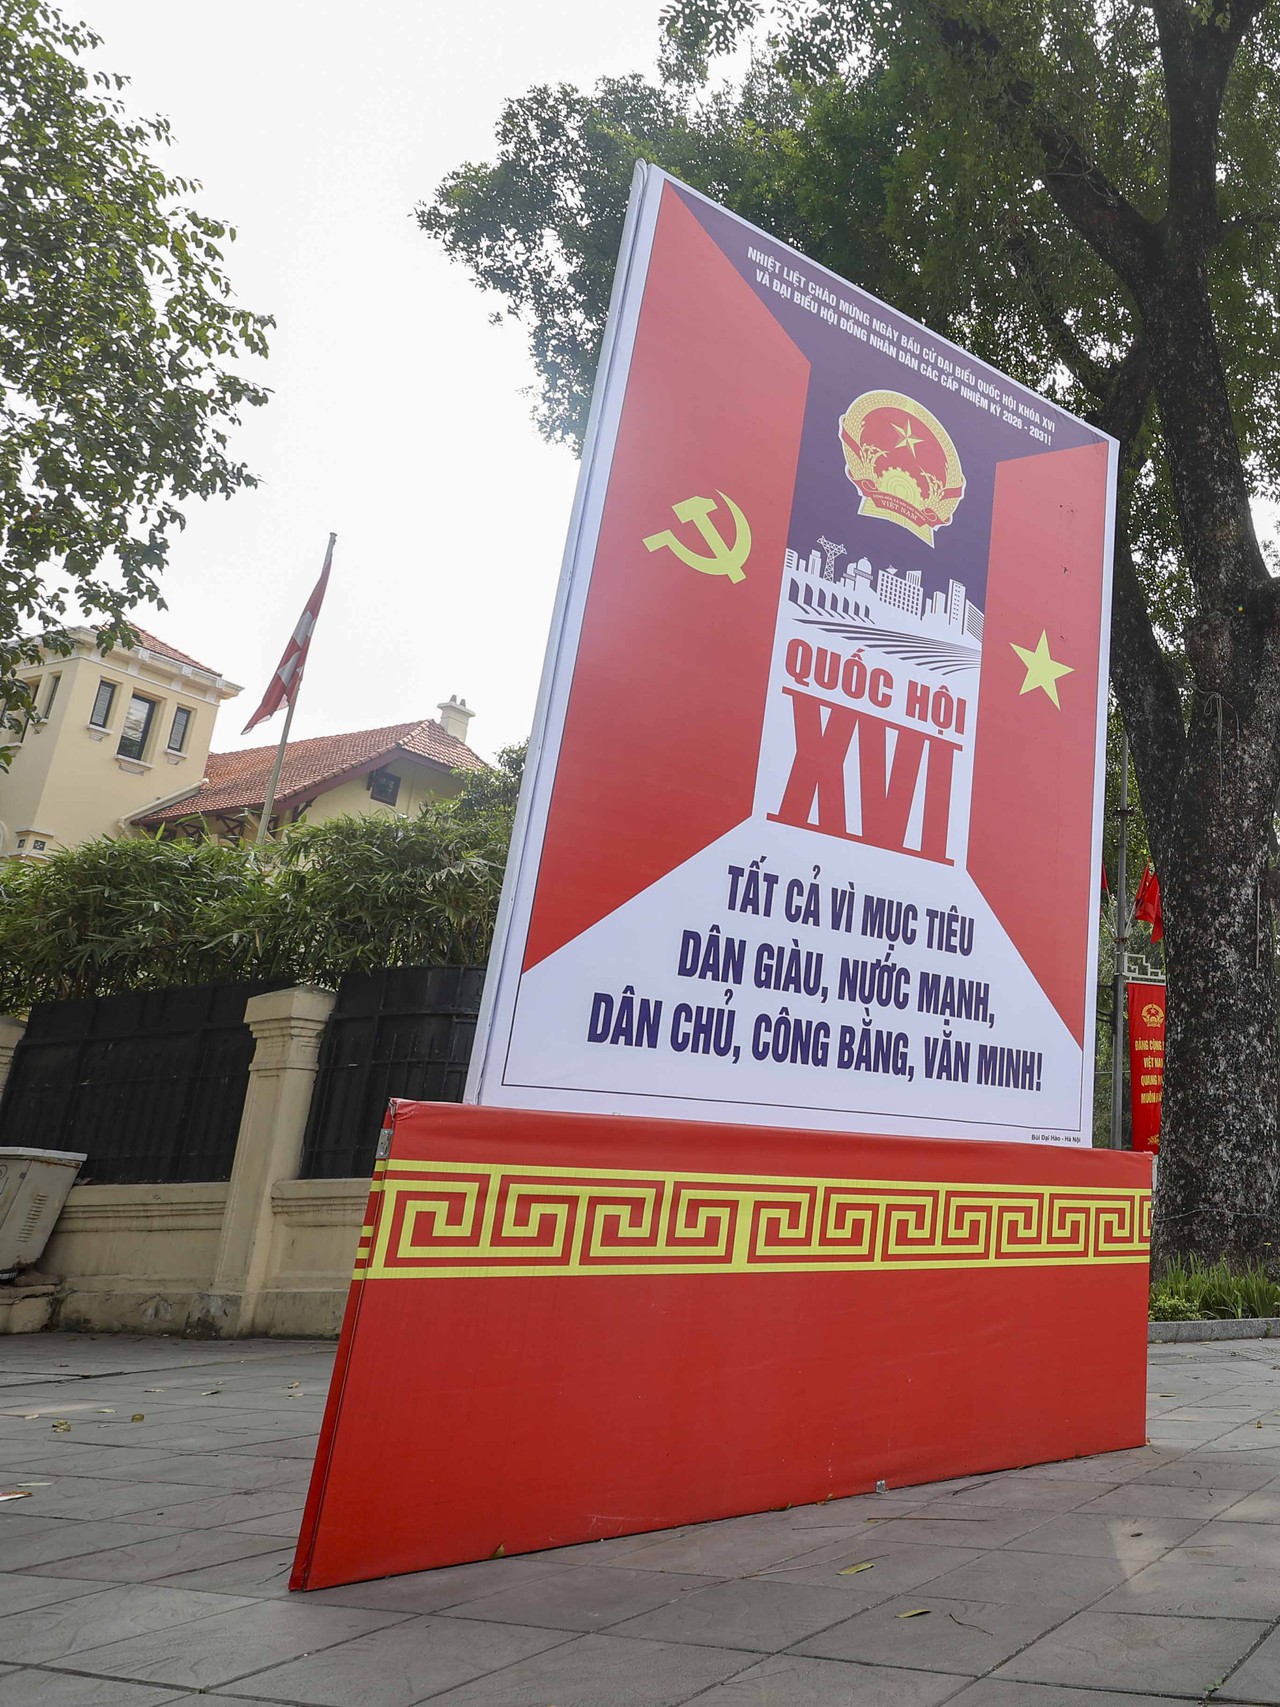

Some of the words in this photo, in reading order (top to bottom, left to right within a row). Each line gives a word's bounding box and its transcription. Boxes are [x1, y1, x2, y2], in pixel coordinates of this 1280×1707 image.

[747, 246, 781, 274] NHIỆT
[783, 266, 806, 288] LIỆT
[808, 281, 837, 306] CHÀO
[839, 299, 870, 327] MỪNG
[872, 318, 899, 342] NGÀY
[922, 347, 937, 363] CỬ
[937, 355, 953, 374] ĐẠI
[955, 366, 976, 386] BIỂU
[977, 378, 1001, 401] QUỐC
[1002, 393, 1017, 411] HỘI
[1018, 403, 1040, 424] KHÓA
[1042, 416, 1056, 433] XVI
[755, 269, 770, 287] VÀ
[772, 278, 792, 299] ĐẠI
[793, 290, 819, 314] BIỂU
[820, 305, 839, 325] HỘI
[839, 317, 868, 342] ĐỒNG
[869, 333, 897, 359] NHÂN
[898, 350, 919, 371] DÂN
[920, 362, 939, 382] CÁC
[940, 374, 959, 392] CẤP
[960, 385, 989, 410] NHIỆM
[990, 402, 1001, 417] KỲ
[1002, 410, 1023, 430] 2026
[1029, 425, 1052, 446] 2031!
[785, 638, 894, 709] QUỐC
[905, 678, 967, 736] HỘI
[766, 685, 963, 867] XVI
[727, 855, 779, 918] TẤT
[785, 864, 821, 927] CẢ
[831, 881, 856, 933] VÌ
[861, 894, 918, 951] MỤC
[925, 905, 975, 957] TIÊU
[677, 924, 747, 985] DÂN
[753, 938, 829, 1004] GIÀU,
[838, 952, 911, 1010] NƯỚC
[917, 971, 995, 1029] MẠNH,
[586, 984, 663, 1049] DÂN
[670, 988, 742, 1064] CHỦ,
[752, 1006, 831, 1068] CÔNG
[837, 1007, 915, 1082] BẰNG,
[924, 1029, 971, 1083] VĂN
[976, 1044, 1043, 1092] MINH!
